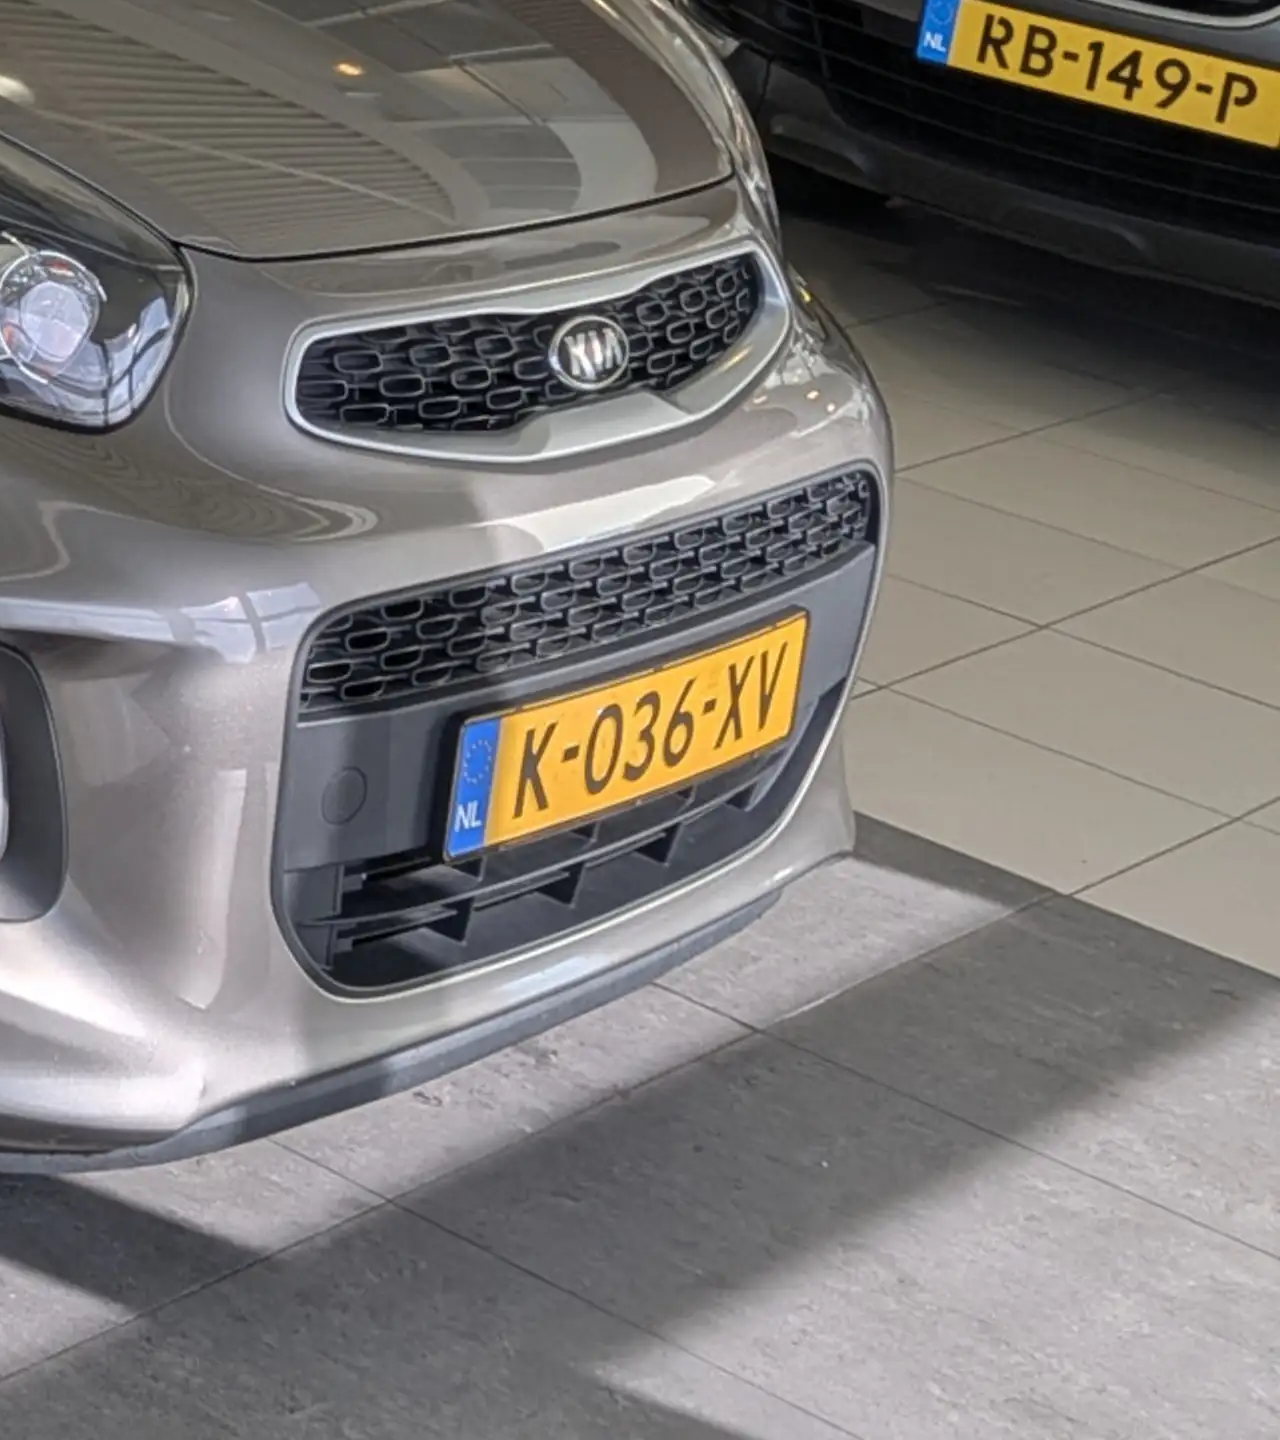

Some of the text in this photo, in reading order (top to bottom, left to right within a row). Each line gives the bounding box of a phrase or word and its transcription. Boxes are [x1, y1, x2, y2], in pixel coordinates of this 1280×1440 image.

[923, 31, 947, 53] NL
[976, 13, 1258, 124] RB-149-P
[563, 327, 624, 380] KIA
[512, 641, 787, 819] K-036-XV
[454, 801, 482, 834] NL
